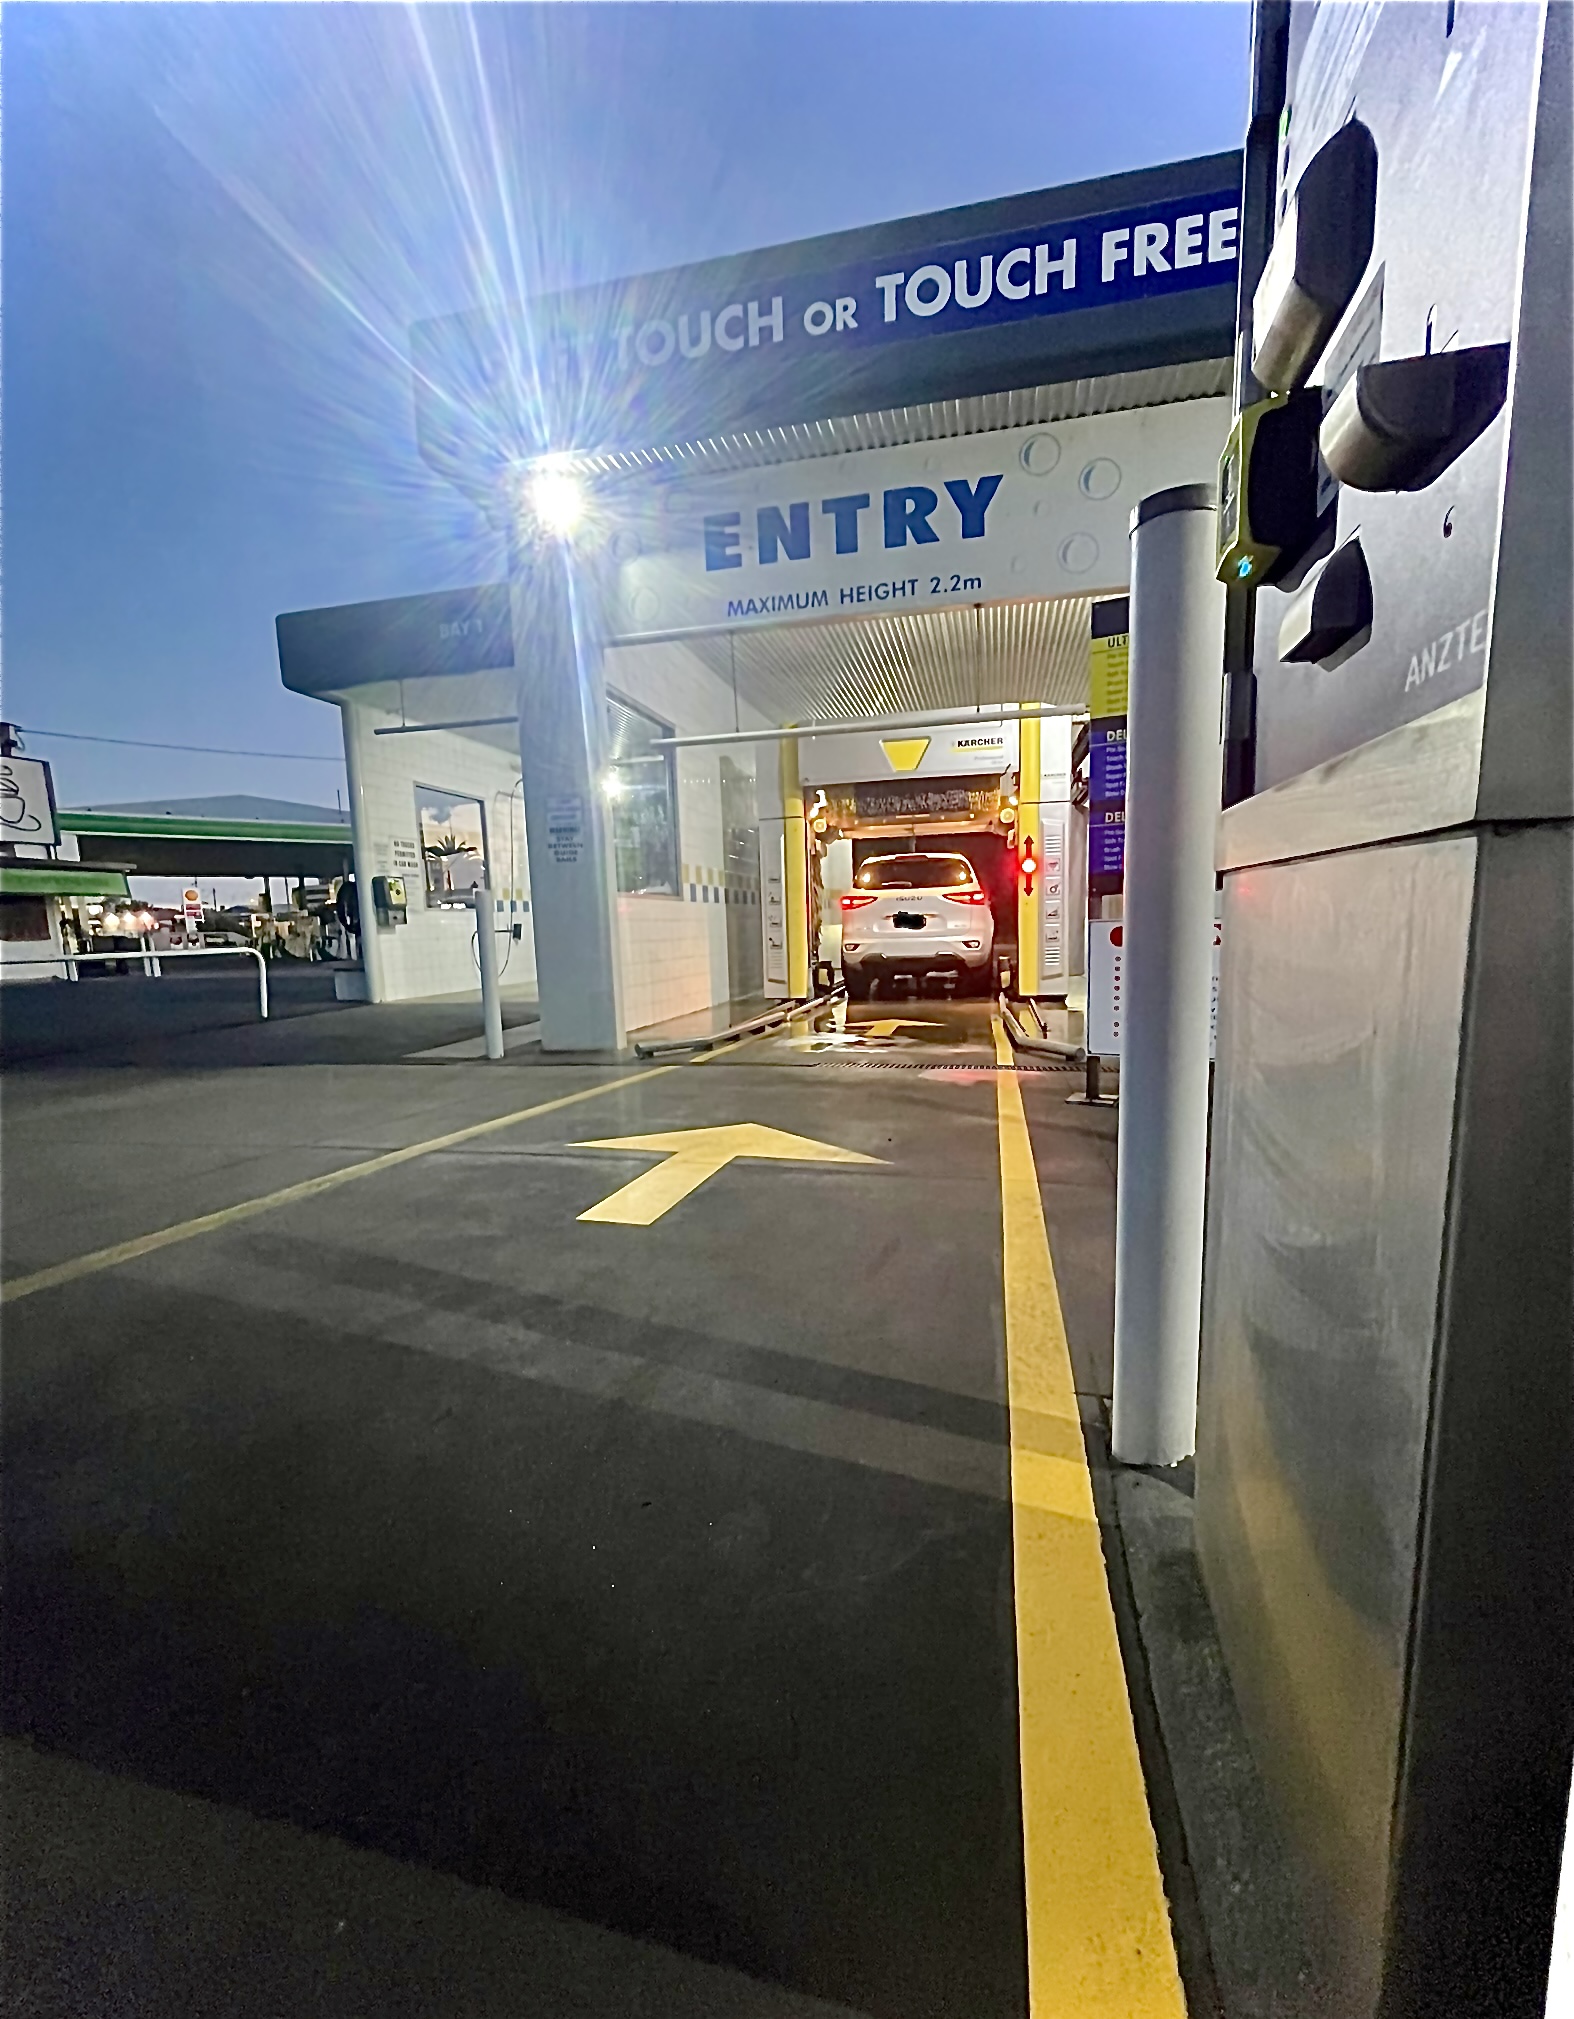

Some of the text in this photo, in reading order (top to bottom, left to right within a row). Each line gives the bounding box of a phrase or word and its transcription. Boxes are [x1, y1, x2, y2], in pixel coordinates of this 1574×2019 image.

[613, 295, 784, 370] TOUCH
[803, 296, 858, 336] OR
[875, 238, 1077, 323] TOUCH
[1101, 206, 1239, 283] FREE
[703, 474, 1004, 572] ENTRY
[440, 621, 469, 639] BAY
[727, 574, 982, 617] MAXIMUM HEIGHT 2.2m
